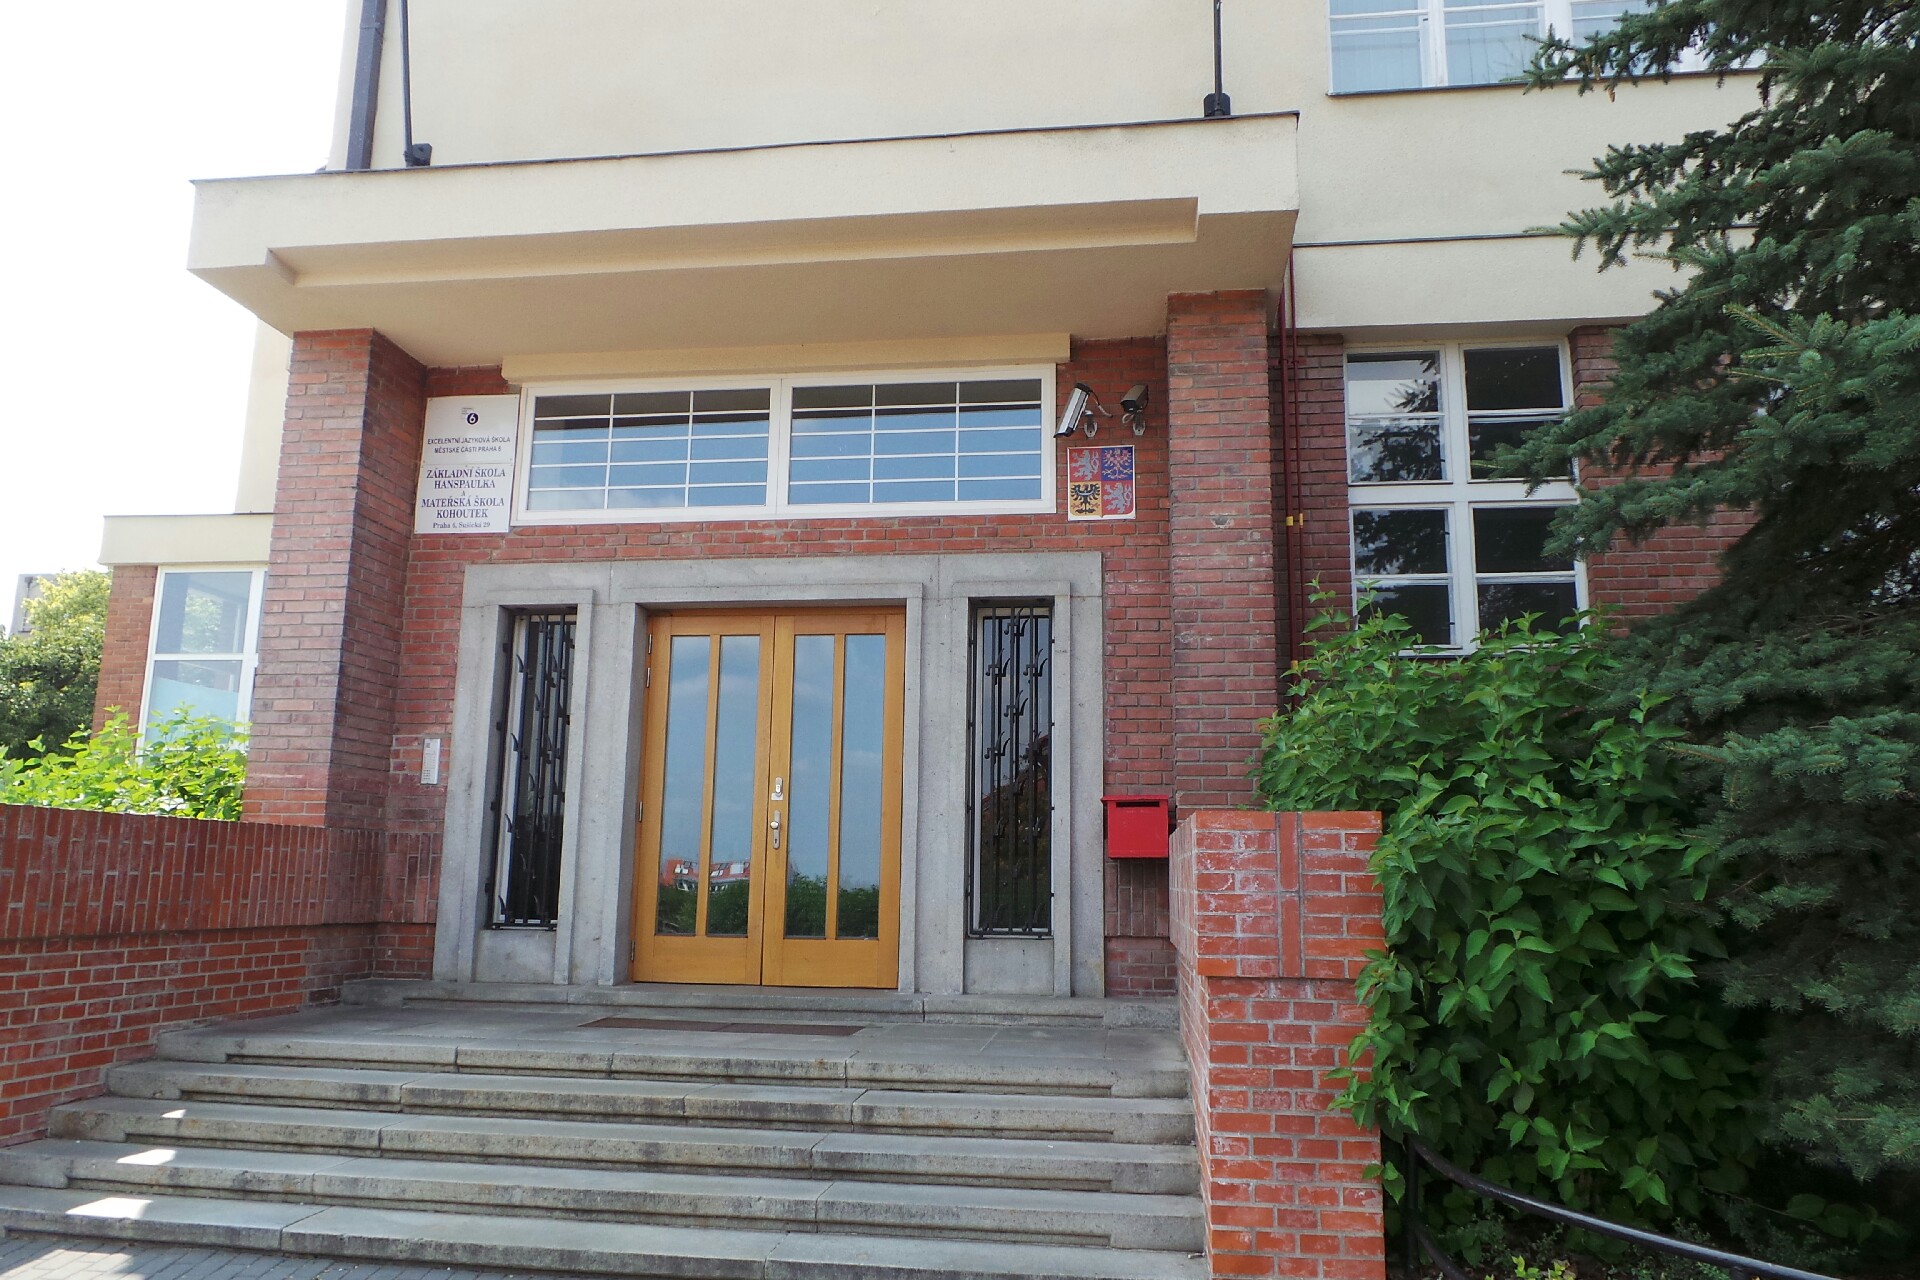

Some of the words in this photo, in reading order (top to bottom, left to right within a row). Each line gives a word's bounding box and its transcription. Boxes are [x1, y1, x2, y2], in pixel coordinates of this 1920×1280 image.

[469, 413, 476, 424] 6
[427, 437, 461, 445] EXCELENTNÍ
[461, 436, 490, 444] JAZYKOVÁ
[491, 435, 510, 443] ŠKOLA
[426, 467, 472, 479] ZÁKLADNÍ
[474, 467, 506, 478] ŠKOLA
[434, 479, 496, 490] HANSPAULKA
[421, 495, 471, 508] MATEŘSKÁ
[473, 495, 505, 507] ŠKOLA
[436, 509, 488, 519] KOHOUTEK
